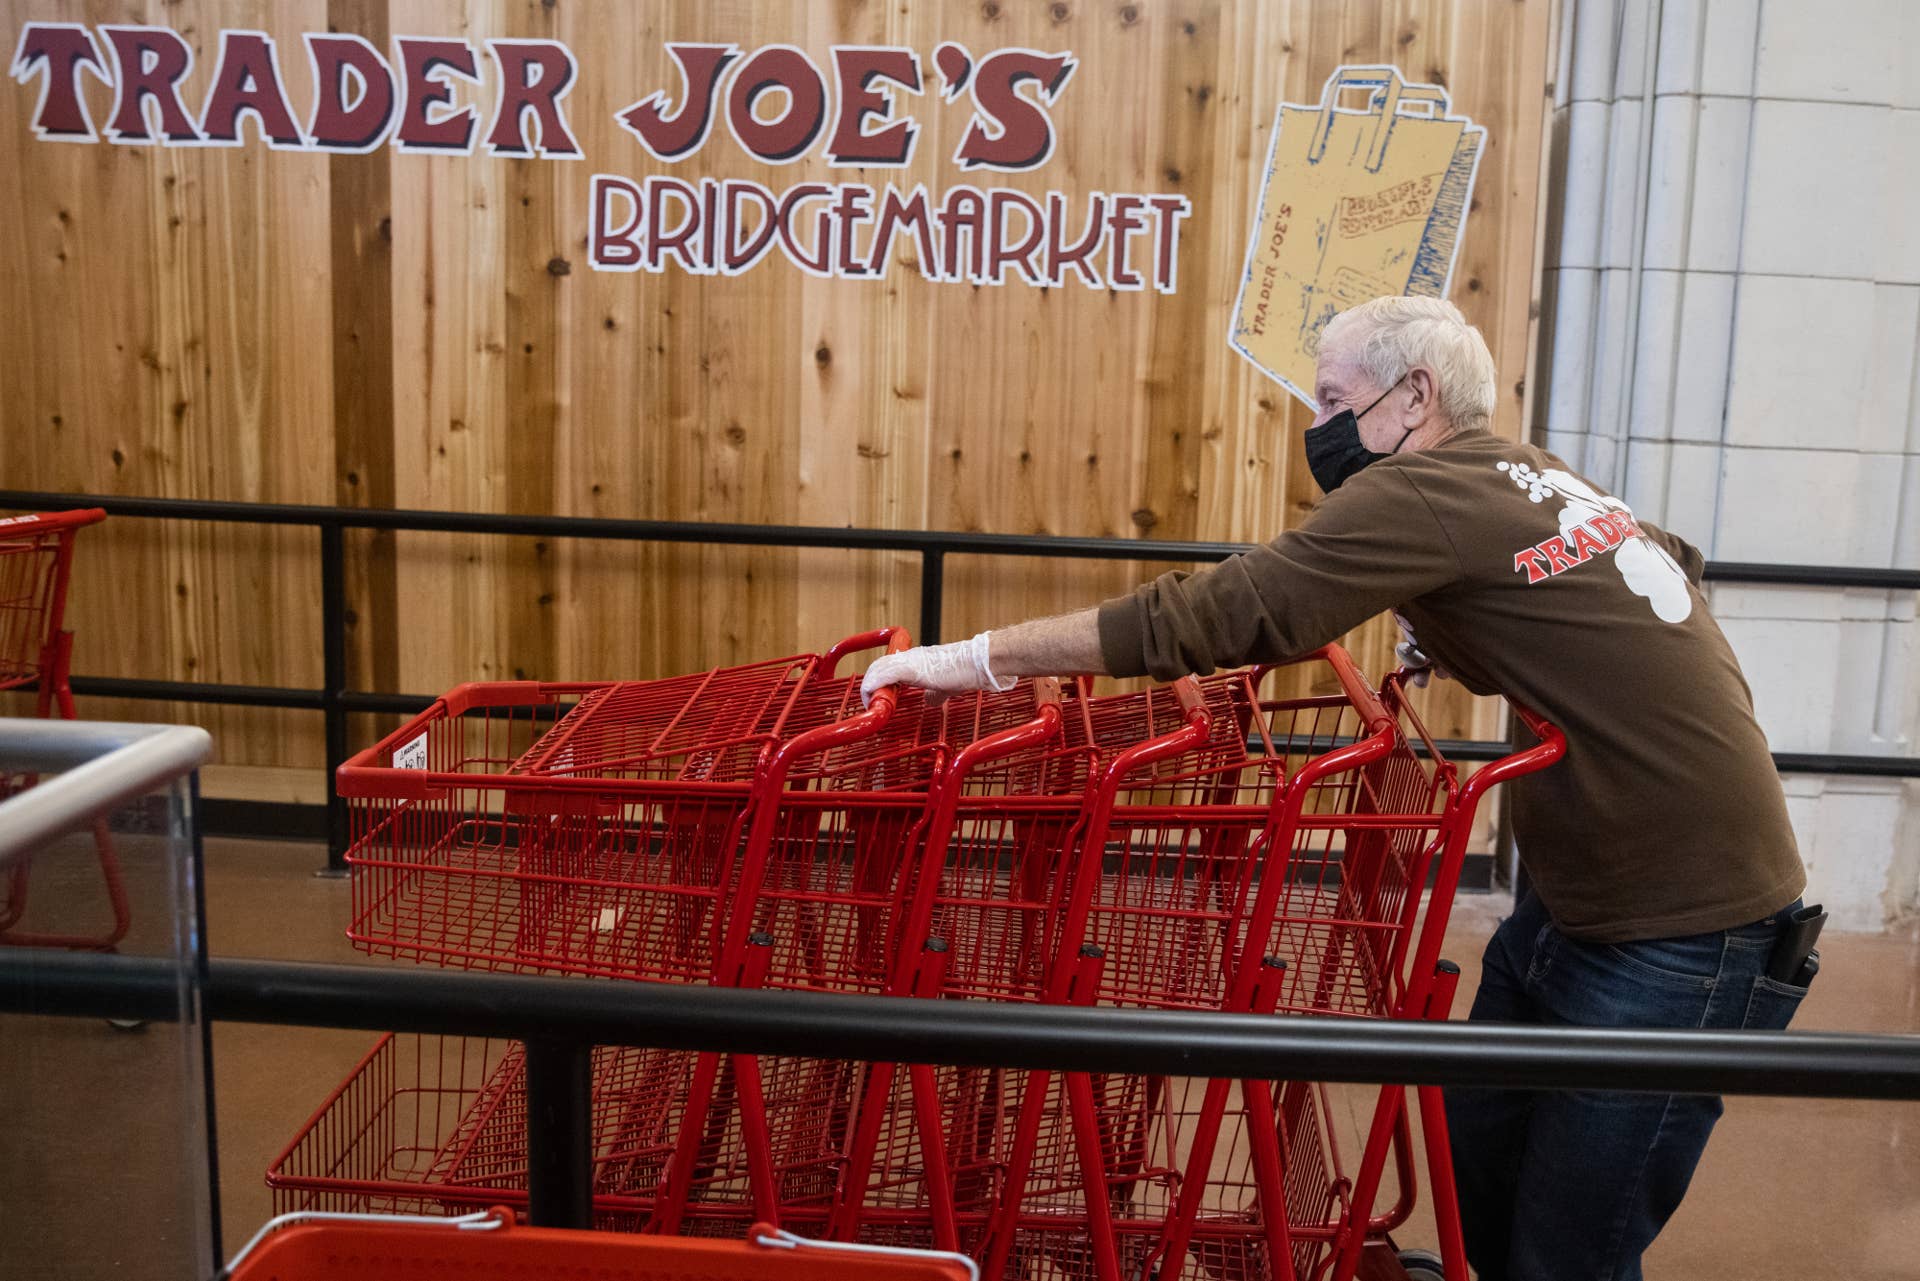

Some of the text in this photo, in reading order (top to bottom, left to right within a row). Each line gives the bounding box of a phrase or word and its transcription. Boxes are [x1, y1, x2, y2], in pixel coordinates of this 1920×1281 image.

[11, 23, 1077, 171] TRADER JOE'S
[588, 175, 1191, 293] BRIDGEMARKET
[1253, 203, 1292, 336] TRADER JOE'S
[1514, 511, 1646, 584] TRADE
